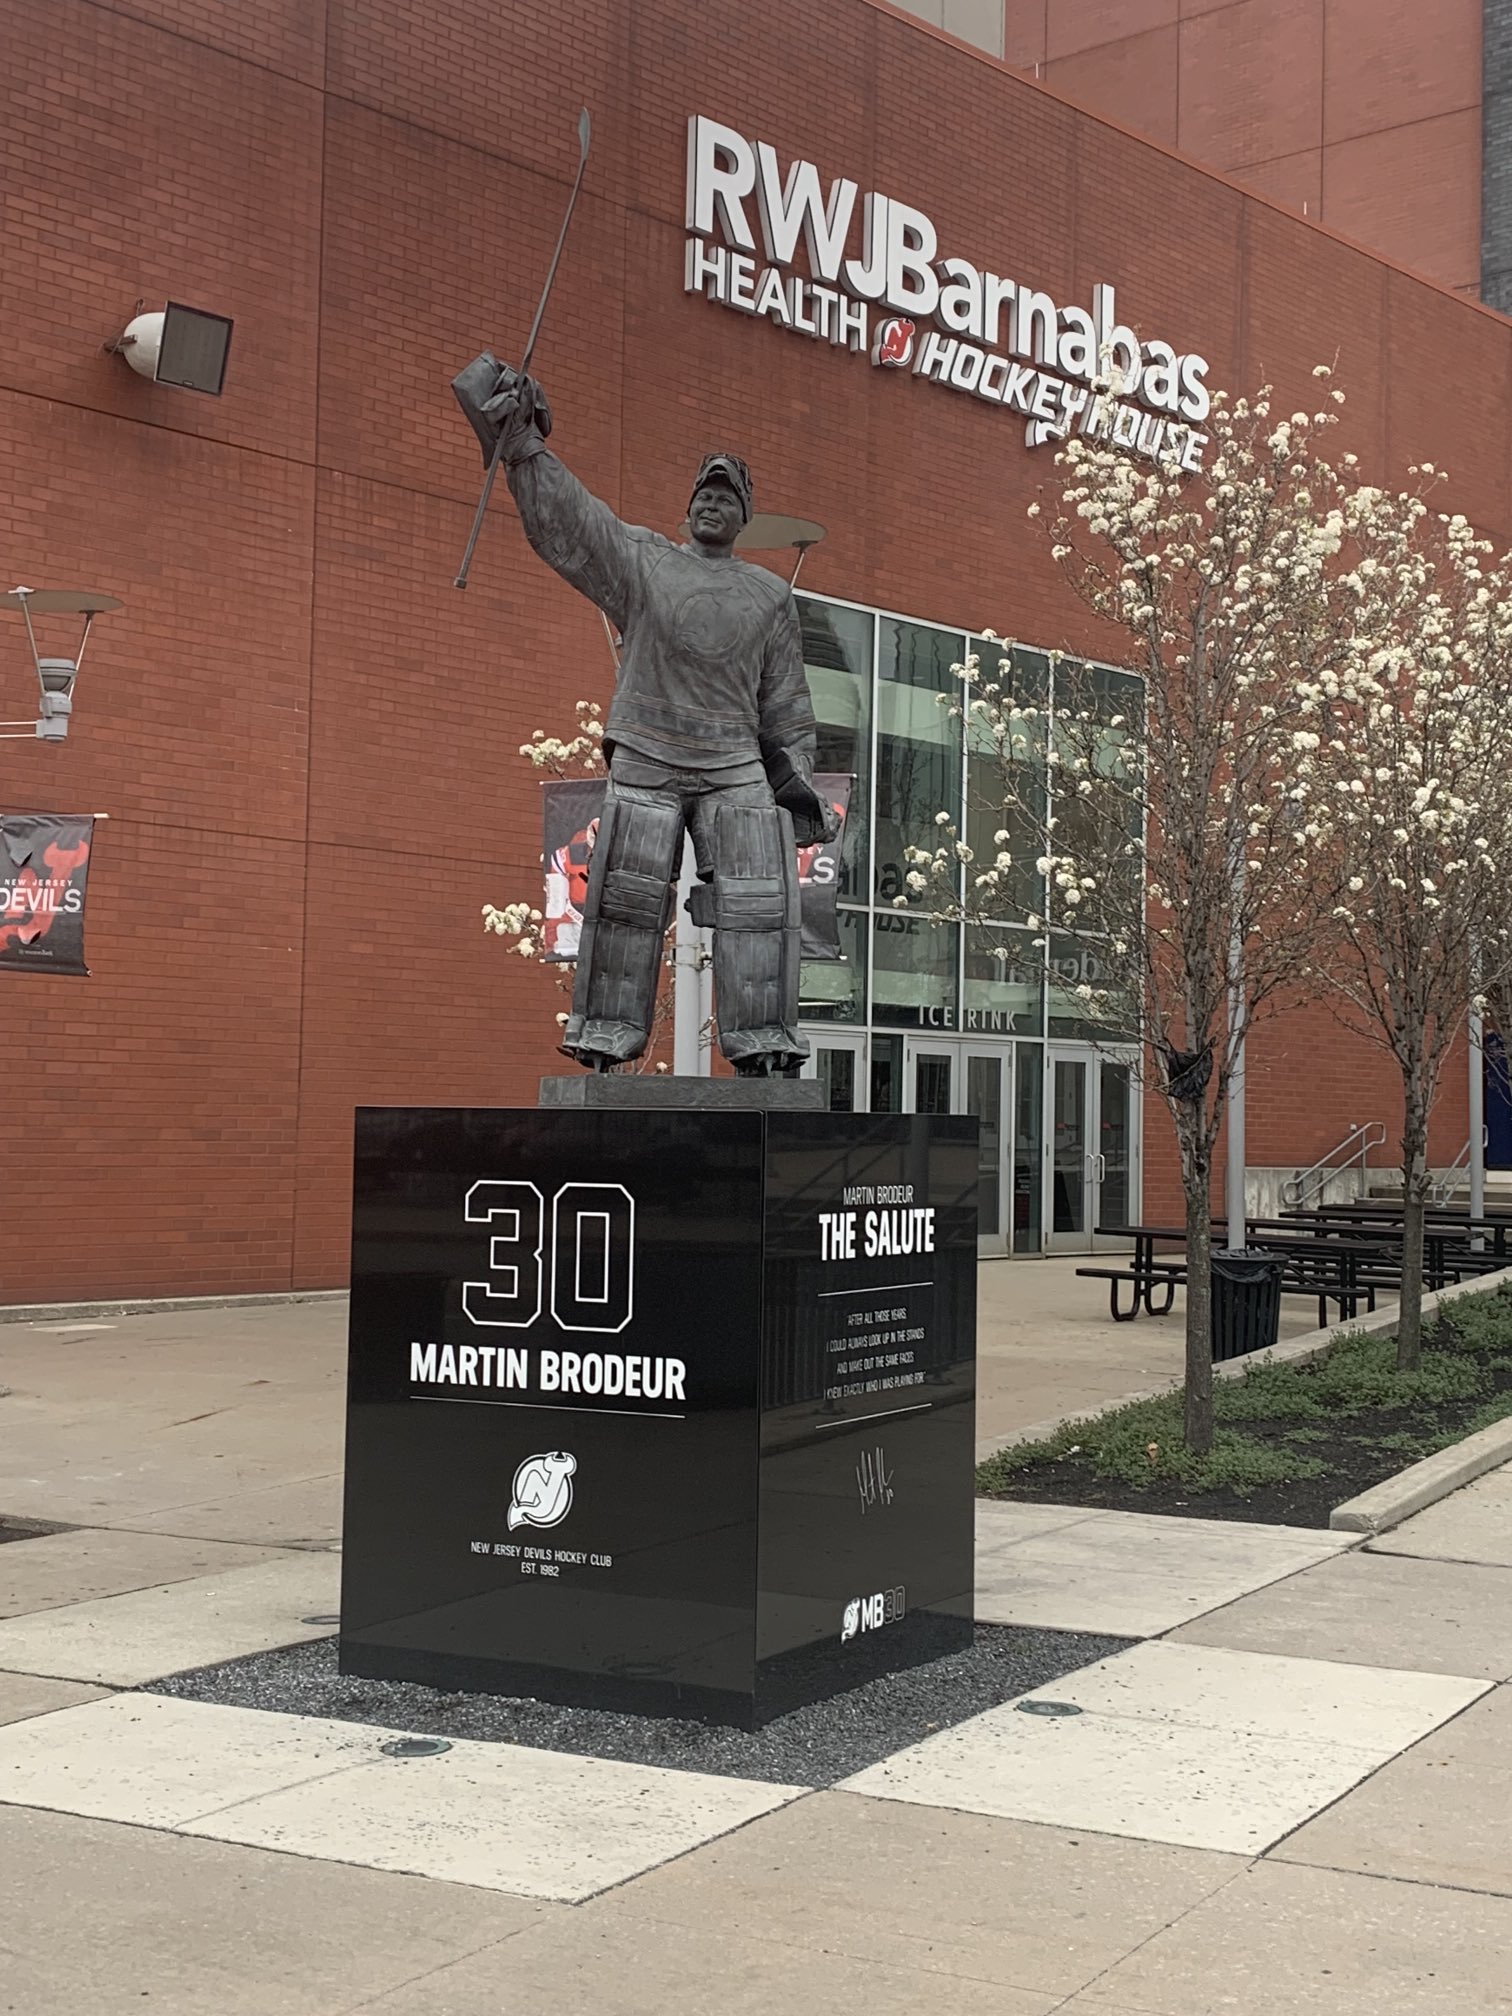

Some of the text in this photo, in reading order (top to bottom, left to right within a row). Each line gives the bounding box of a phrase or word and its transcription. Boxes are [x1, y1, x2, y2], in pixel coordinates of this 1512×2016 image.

[686, 114, 1210, 422] RWJBarnabas
[685, 237, 867, 351] HEALTH
[913, 332, 1088, 447] HOCKEY
[0, 887, 82, 912] DEVILS
[919, 1004, 1017, 1031] ICE RINK
[843, 1185, 914, 1206] MARTIN BRODEUR
[819, 1208, 935, 1261] THE SALUTE
[463, 1179, 635, 1333] 30
[864, 1312, 873, 1324] ALL
[874, 1310, 890, 1323] THOSE
[830, 1338, 847, 1352] COULD
[848, 1335, 868, 1349] ALWAYS
[868, 1333, 881, 1347] LOOK
[882, 1332, 890, 1344] UP
[897, 1330, 906, 1342] THE
[906, 1327, 925, 1341] STANDS
[410, 1342, 686, 1400] MARTIN BRODEUR
[837, 1361, 848, 1374] AND
[863, 1357, 874, 1370] OUT
[875, 1356, 885, 1368] THE
[885, 1353, 899, 1367] SAME
[866, 1379, 878, 1393] WHO
[470, 1541, 613, 1567] NEW JERSEY DEVILS HOCKEY CLUB
[540, 1564, 560, 1577] 1982
